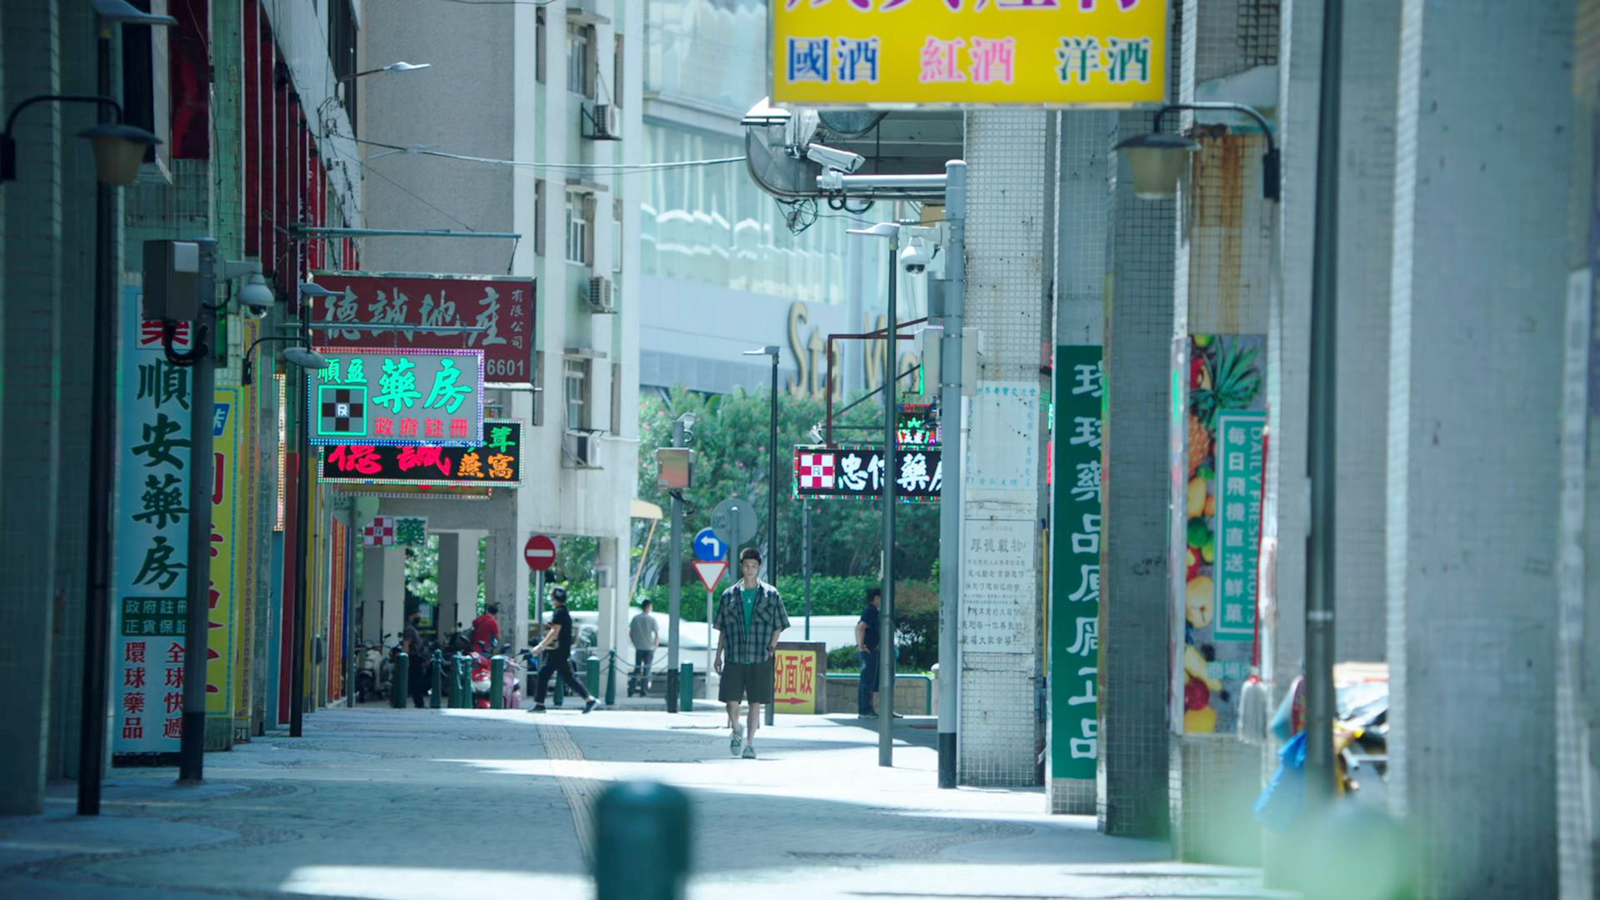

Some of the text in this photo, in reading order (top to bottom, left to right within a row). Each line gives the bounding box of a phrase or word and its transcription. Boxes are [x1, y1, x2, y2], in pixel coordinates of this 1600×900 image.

[787, 37, 1152, 83] 國酒 紅酒 洋酒
[511, 289, 524, 349] 有限公司
[372, 357, 473, 414] 藥房
[487, 358, 524, 377] 6601
[374, 416, 469, 438] 政府註冊
[1250, 426, 1263, 484] DAILY
[131, 357, 192, 591] 順安藥房
[1249, 490, 1261, 550] FRESH
[125, 600, 187, 614] 政府註冊
[122, 641, 147, 740] 環球藥品
[162, 642, 187, 739] 全球快遞
